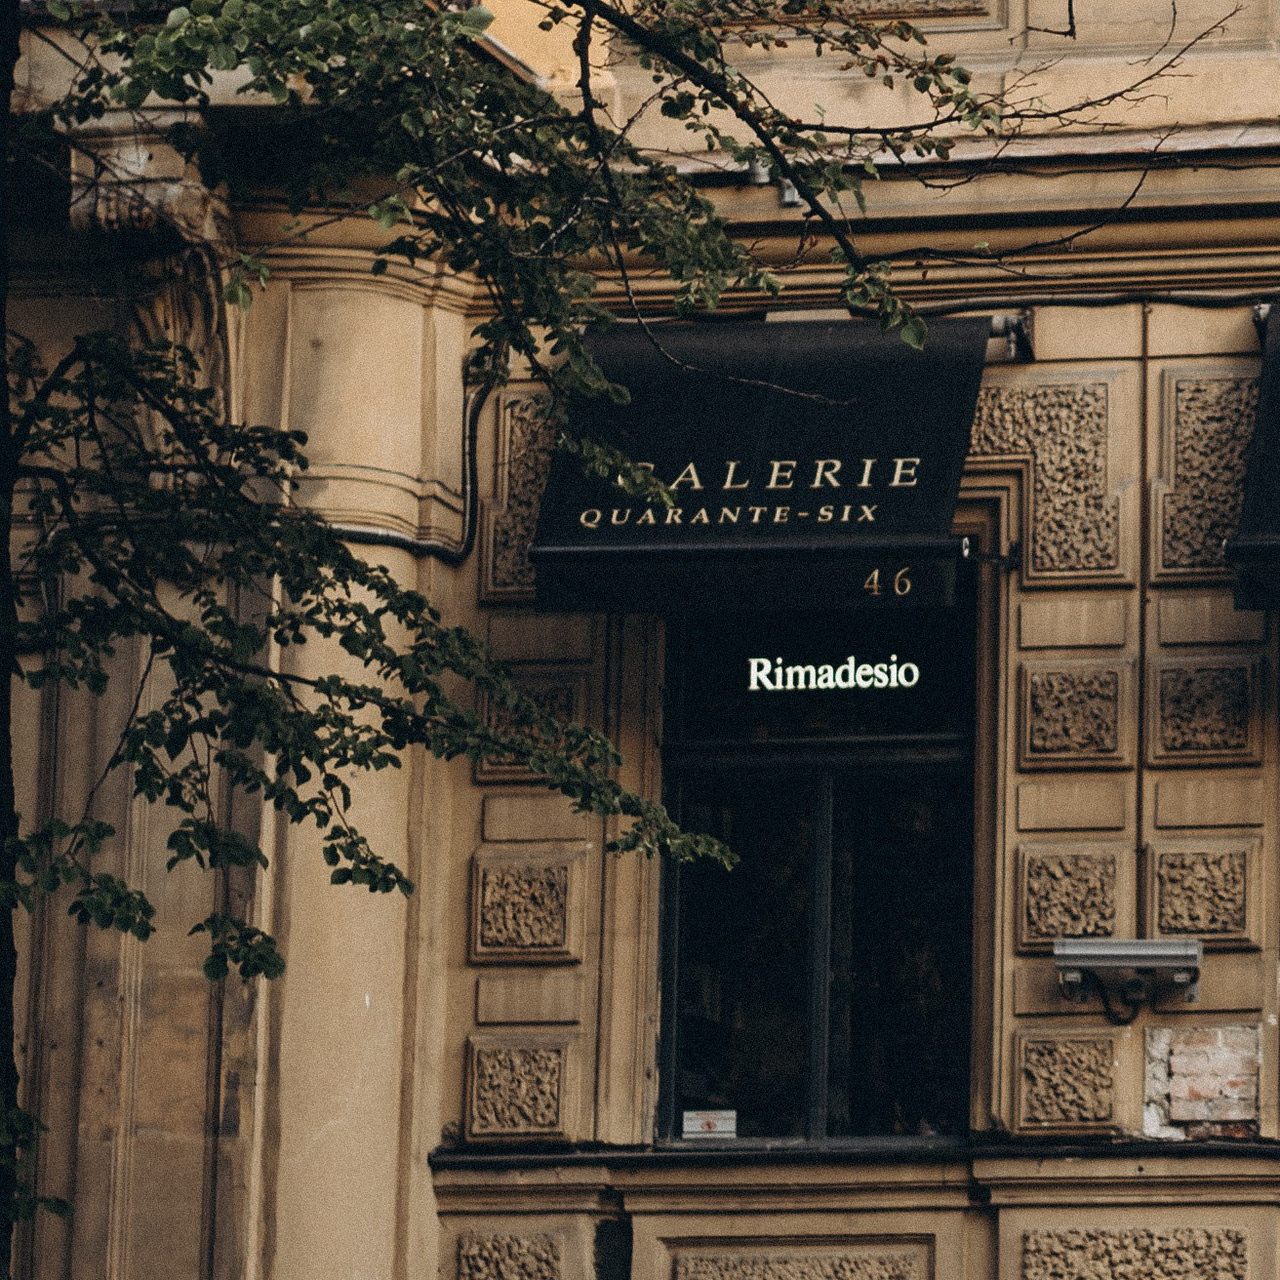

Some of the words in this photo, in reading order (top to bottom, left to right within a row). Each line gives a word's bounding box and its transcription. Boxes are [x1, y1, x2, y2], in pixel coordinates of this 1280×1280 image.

[579, 504, 878, 529] QUARANTE-SIX
[863, 567, 912, 596] 46
[748, 654, 920, 691] Rimadesio
